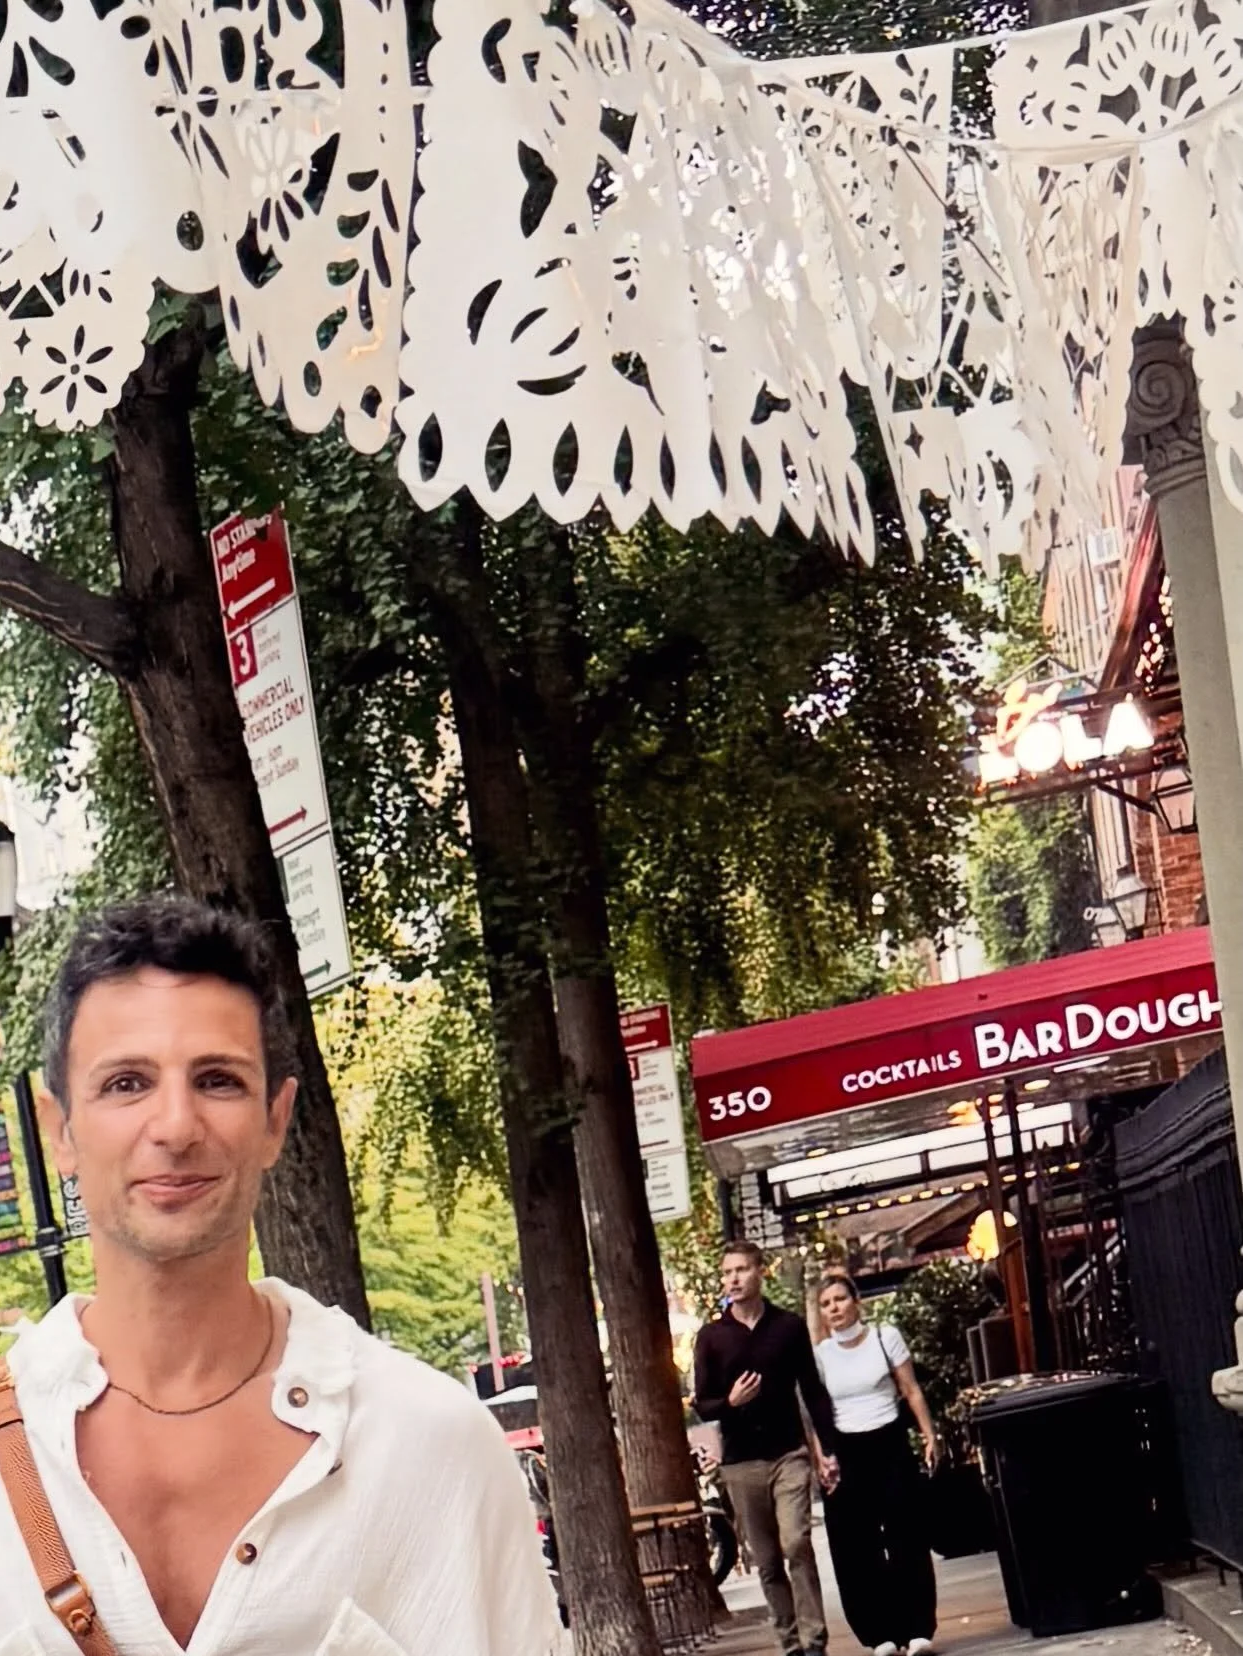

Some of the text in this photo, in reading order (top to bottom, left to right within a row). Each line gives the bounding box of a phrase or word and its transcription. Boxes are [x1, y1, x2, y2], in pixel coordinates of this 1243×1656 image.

[235, 632, 252, 676] 3
[708, 1086, 772, 1121] 350
[841, 1050, 963, 1093] COCKTAILS
